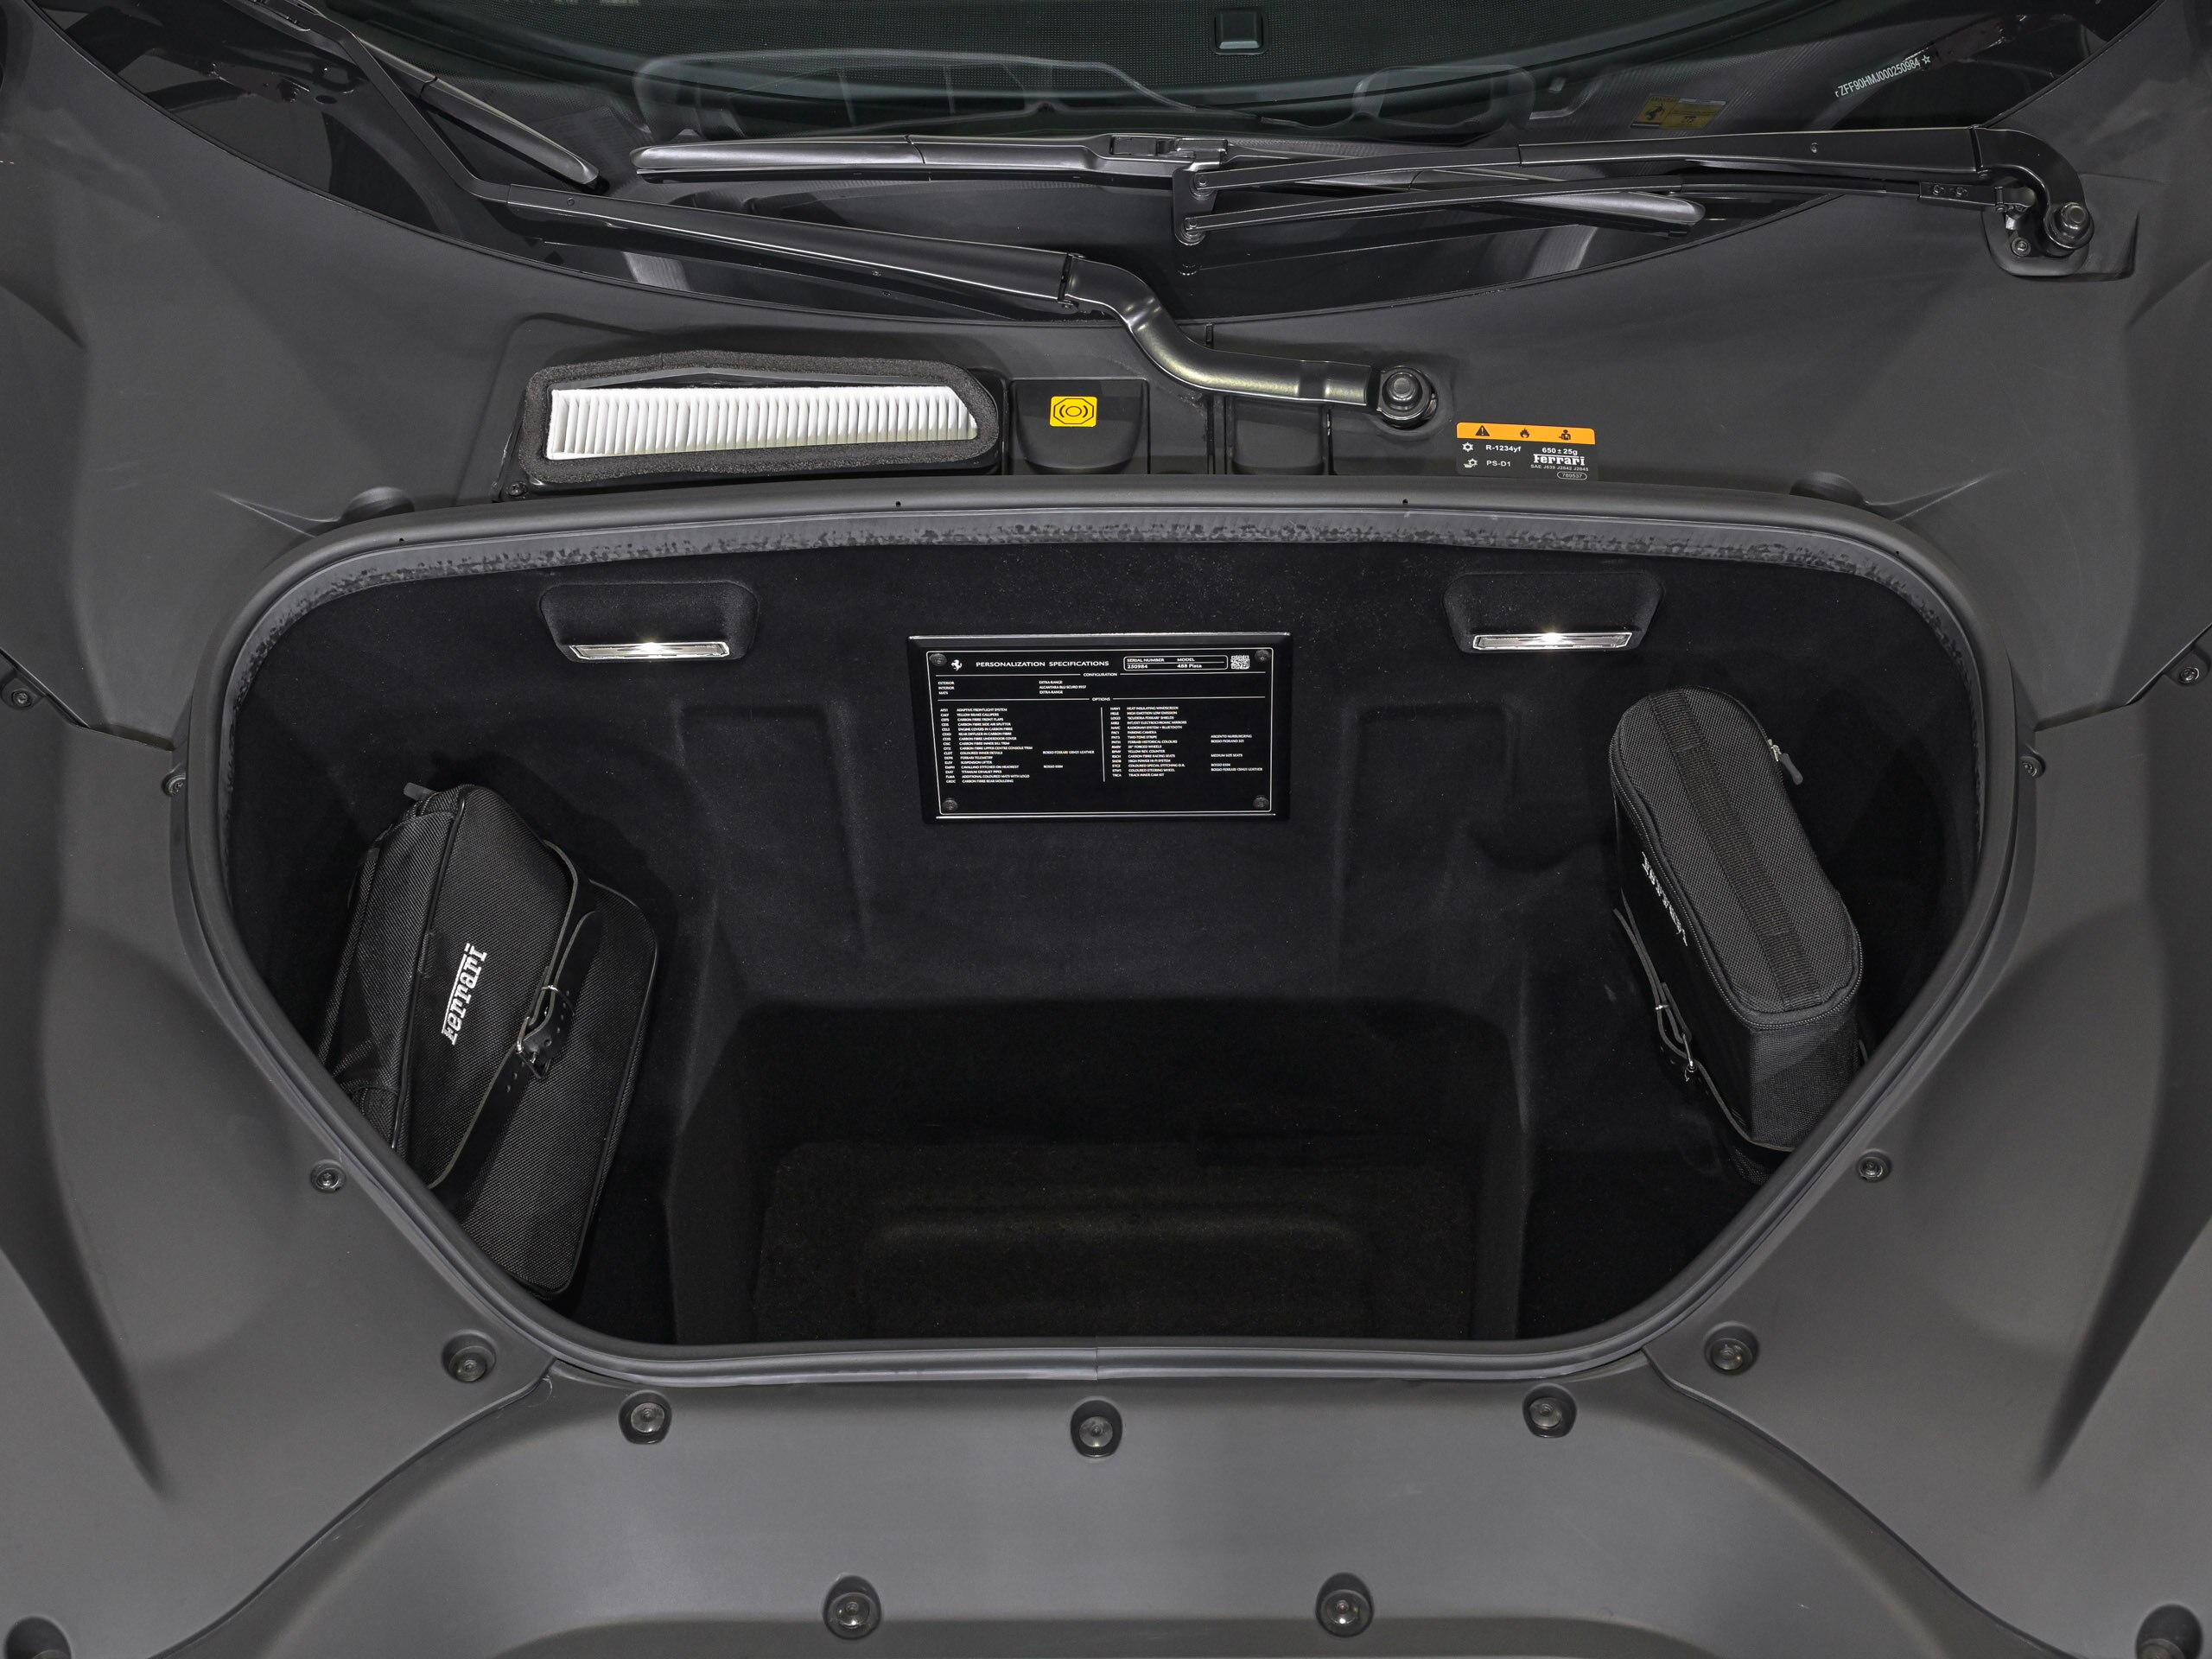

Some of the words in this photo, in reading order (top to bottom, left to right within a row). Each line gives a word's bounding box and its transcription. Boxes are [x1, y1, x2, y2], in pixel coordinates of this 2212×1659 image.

[1838, 57, 1920, 96] ZFF90HMJ000250984
[1533, 454, 1585, 465] Ferrari
[441, 943, 487, 1046] Ferrari
